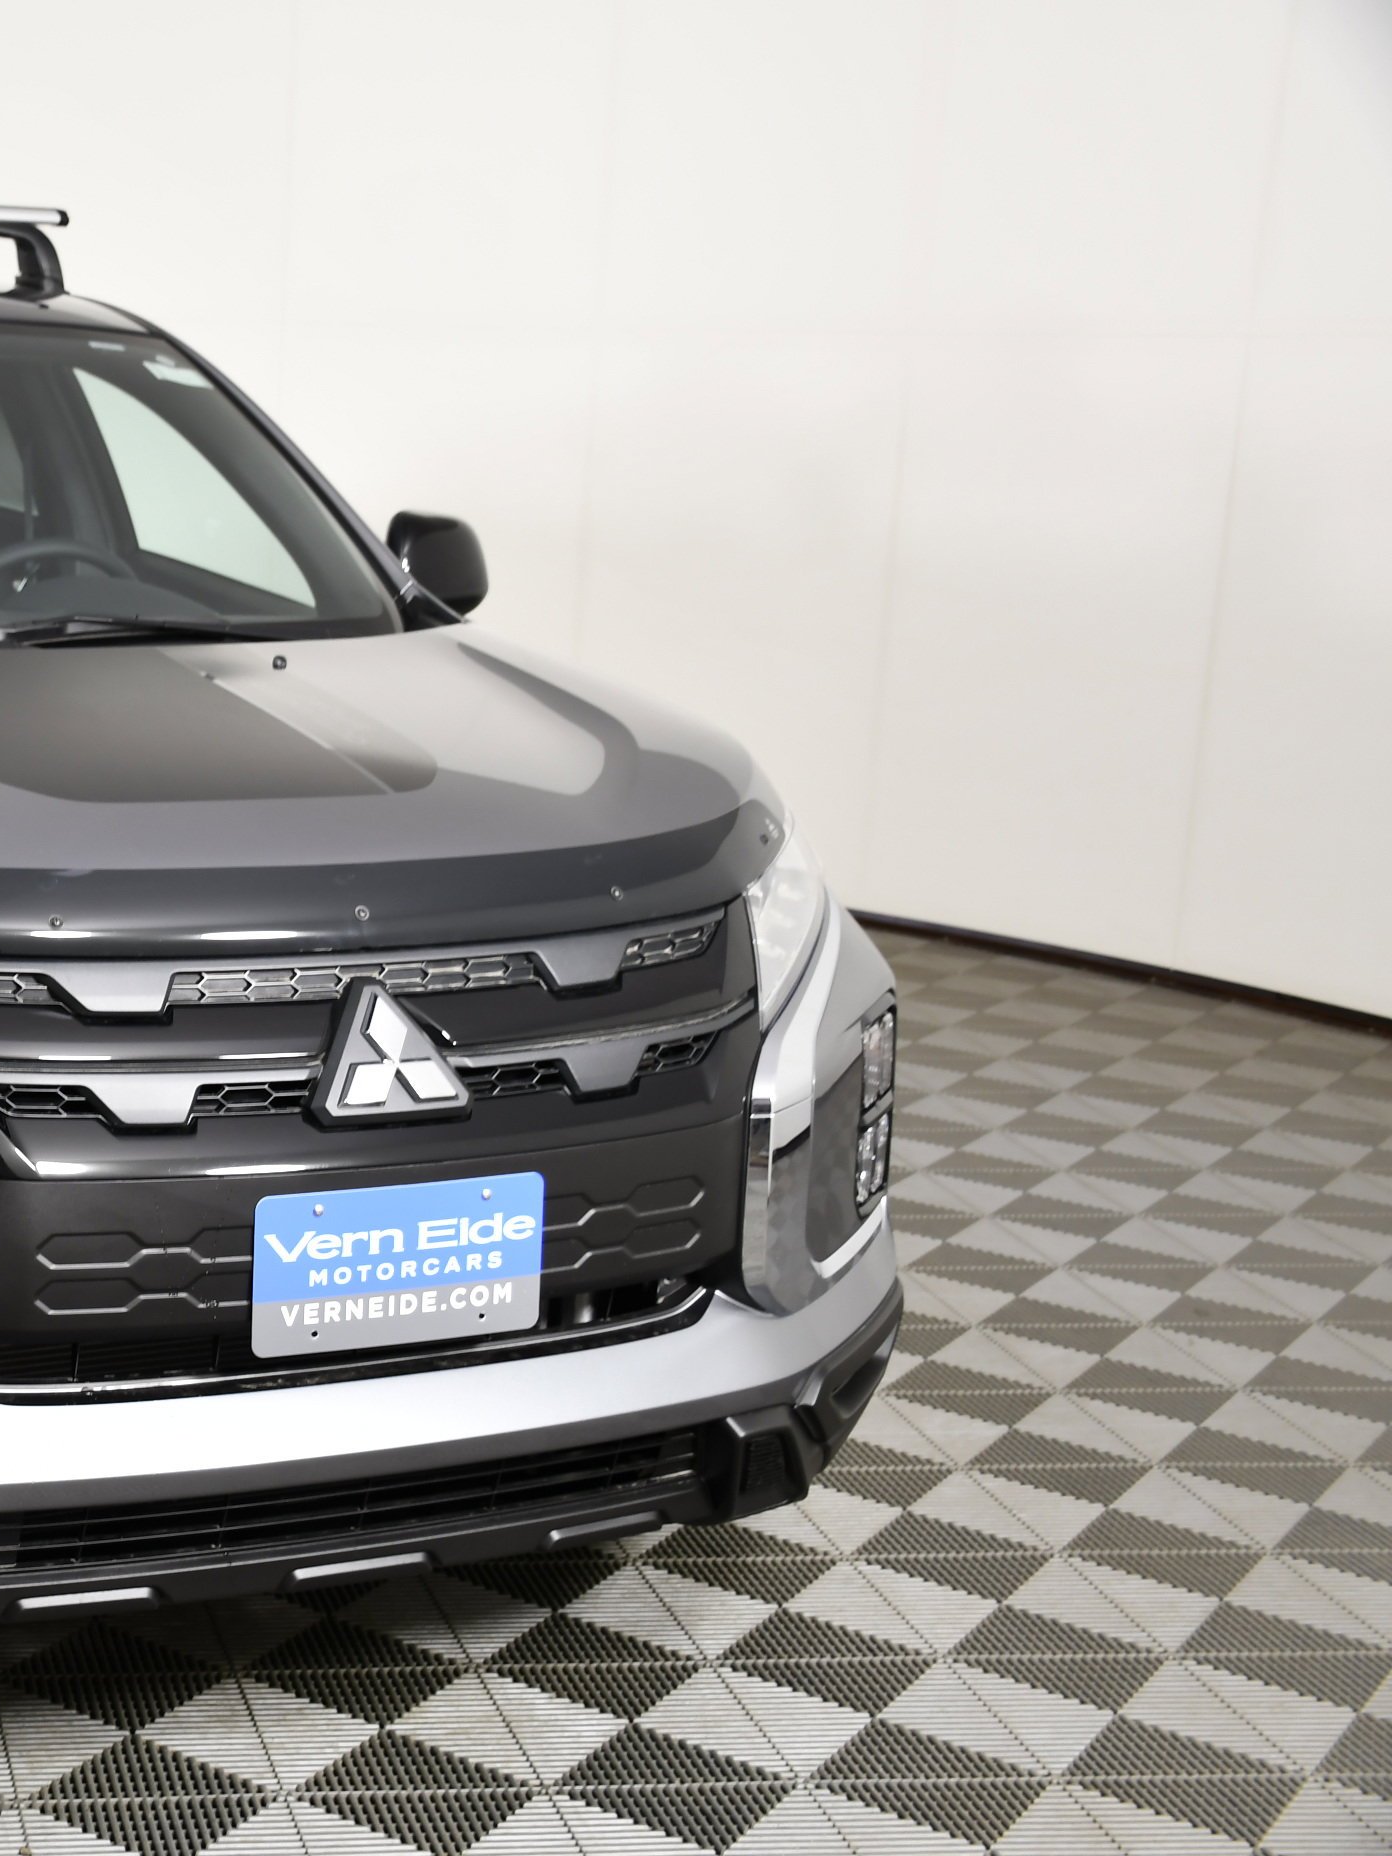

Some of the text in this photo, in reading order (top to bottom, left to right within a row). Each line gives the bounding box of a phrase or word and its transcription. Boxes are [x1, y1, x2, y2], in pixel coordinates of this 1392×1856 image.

[264, 1226, 405, 1263] Vern
[309, 1250, 503, 1287] MOTORCARS
[280, 1281, 513, 1327] VERNEIDE.COM
